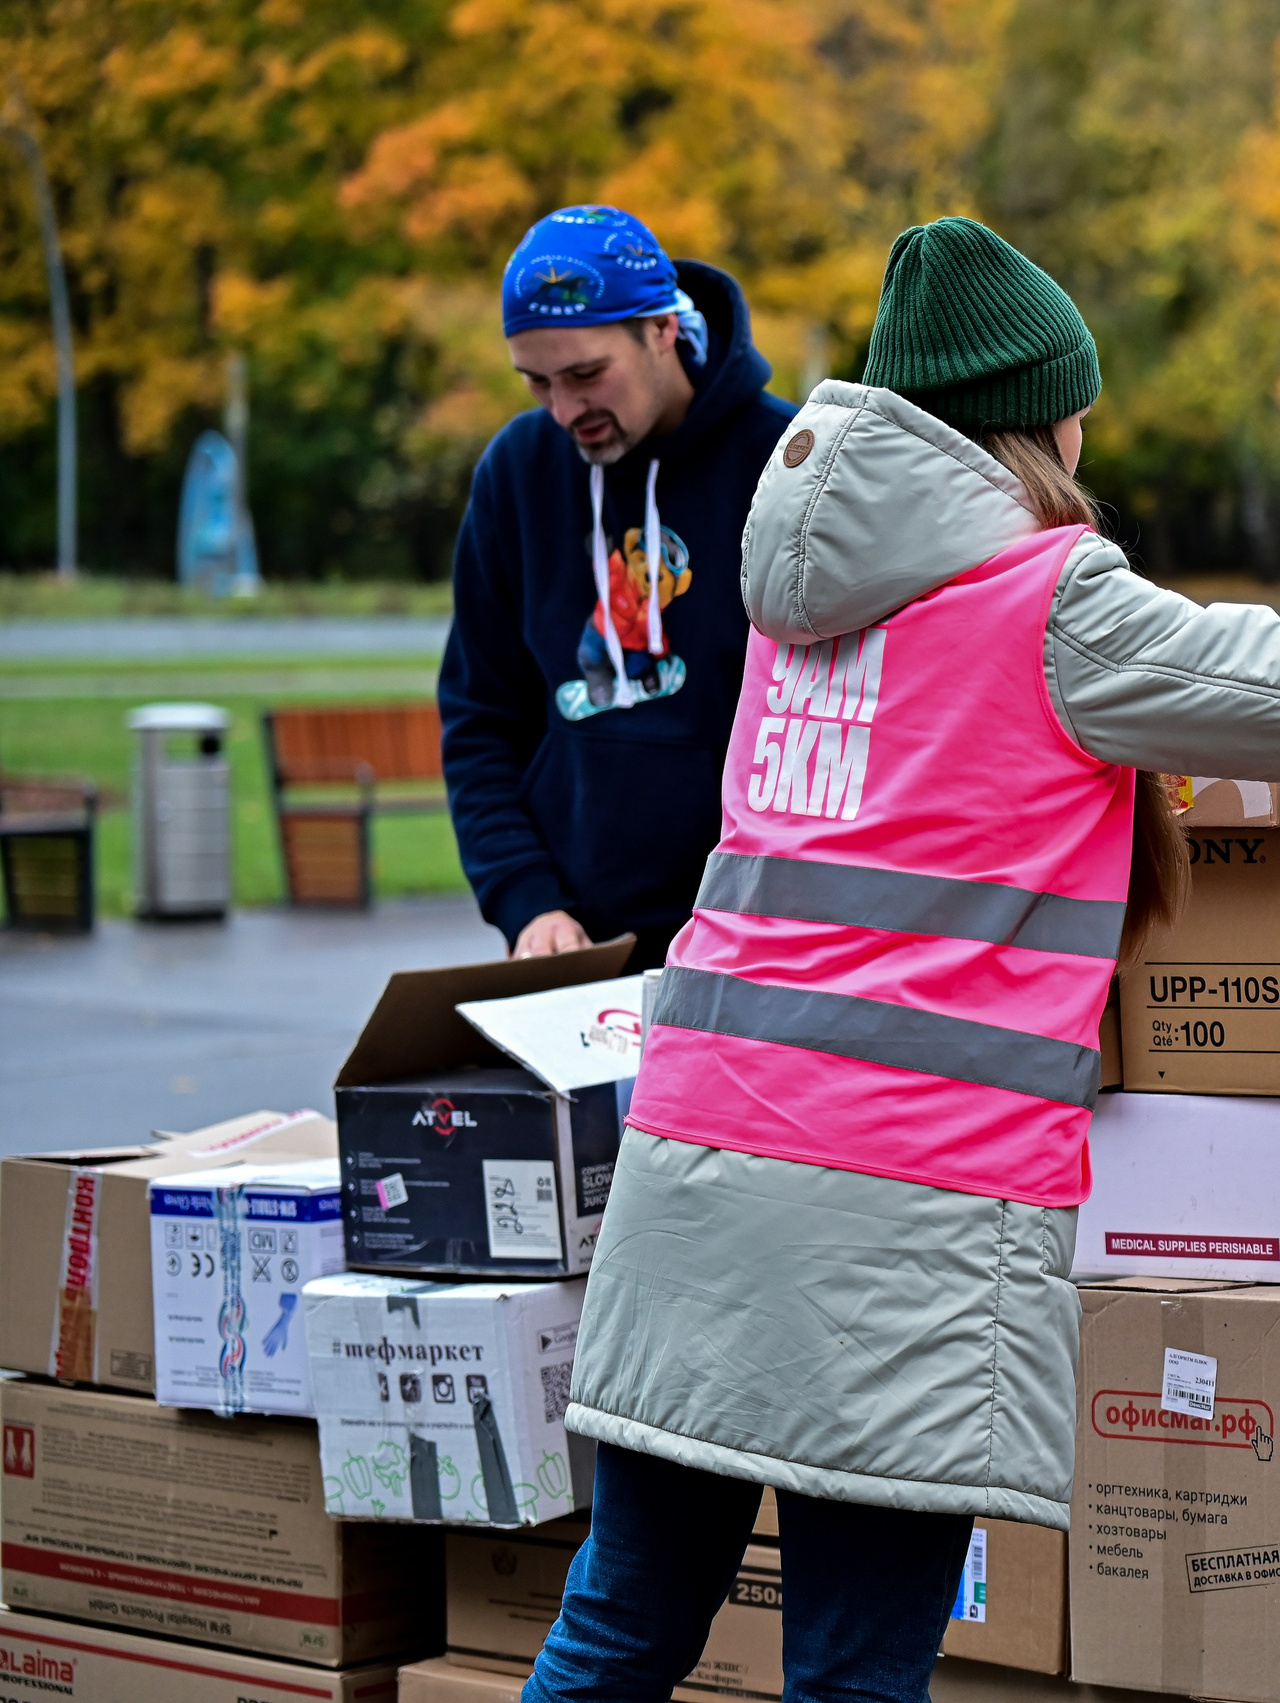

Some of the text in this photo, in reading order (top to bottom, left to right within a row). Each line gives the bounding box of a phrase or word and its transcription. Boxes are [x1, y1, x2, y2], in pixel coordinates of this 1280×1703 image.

[766, 629, 888, 723] 9AM
[747, 716, 871, 822] 5KM
[1187, 838, 1266, 864] NY
[1149, 975, 1280, 1004] UPP-110S
[1152, 1020, 1172, 1034] Qty
[1152, 1034, 1173, 1047] Qté
[1111, 1238, 1274, 1255] MEDICAL SUPPLIES PERISHABLE
[1096, 1483, 1247, 1508] оргтехника, картриджи
[1096, 1503, 1228, 1526] канцтовары, бумага
[1096, 1524, 1167, 1543] хозтовары
[1096, 1544, 1144, 1559] мебель
[1191, 1549, 1280, 1573] БЕСПЛАТНАЯ
[1096, 1562, 1149, 1580] бакалея
[1193, 1571, 1244, 1589] ДОСТАВКА
[1245, 1570, 1252, 1581] В
